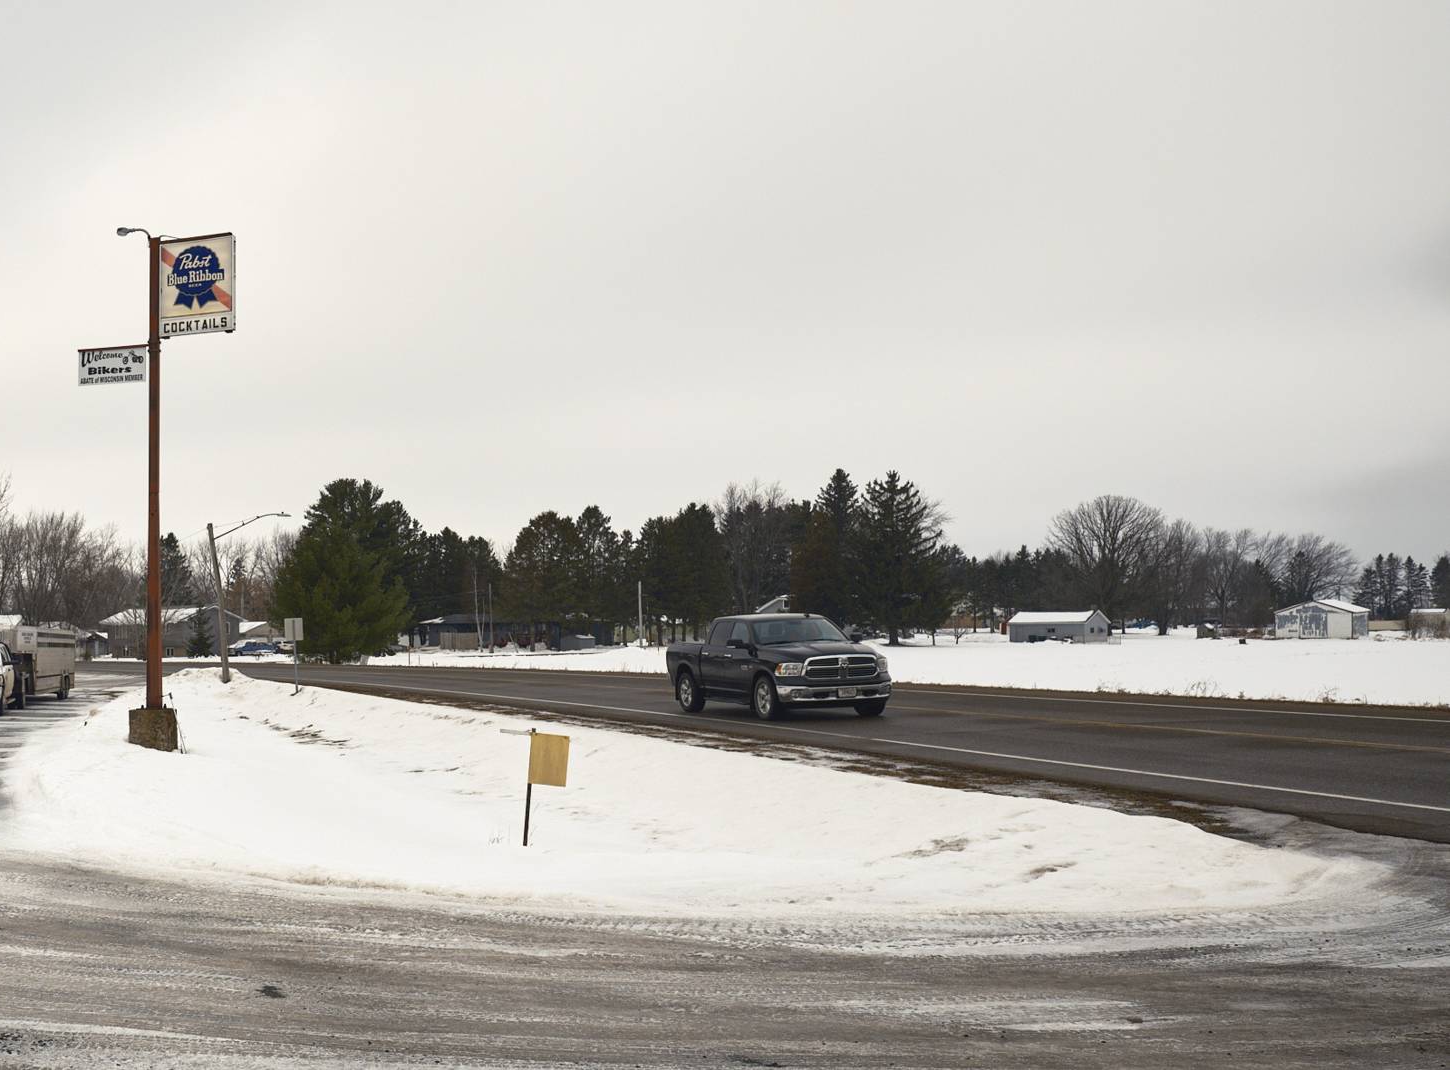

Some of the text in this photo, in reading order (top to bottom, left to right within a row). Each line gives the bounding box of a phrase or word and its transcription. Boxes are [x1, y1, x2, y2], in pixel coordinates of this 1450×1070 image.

[179, 253, 212, 270] Pabst
[167, 269, 224, 286] Blue Ribbon
[163, 317, 228, 334] COCKTAILS
[81, 350, 123, 368] Welcome
[87, 366, 132, 376] Bikers
